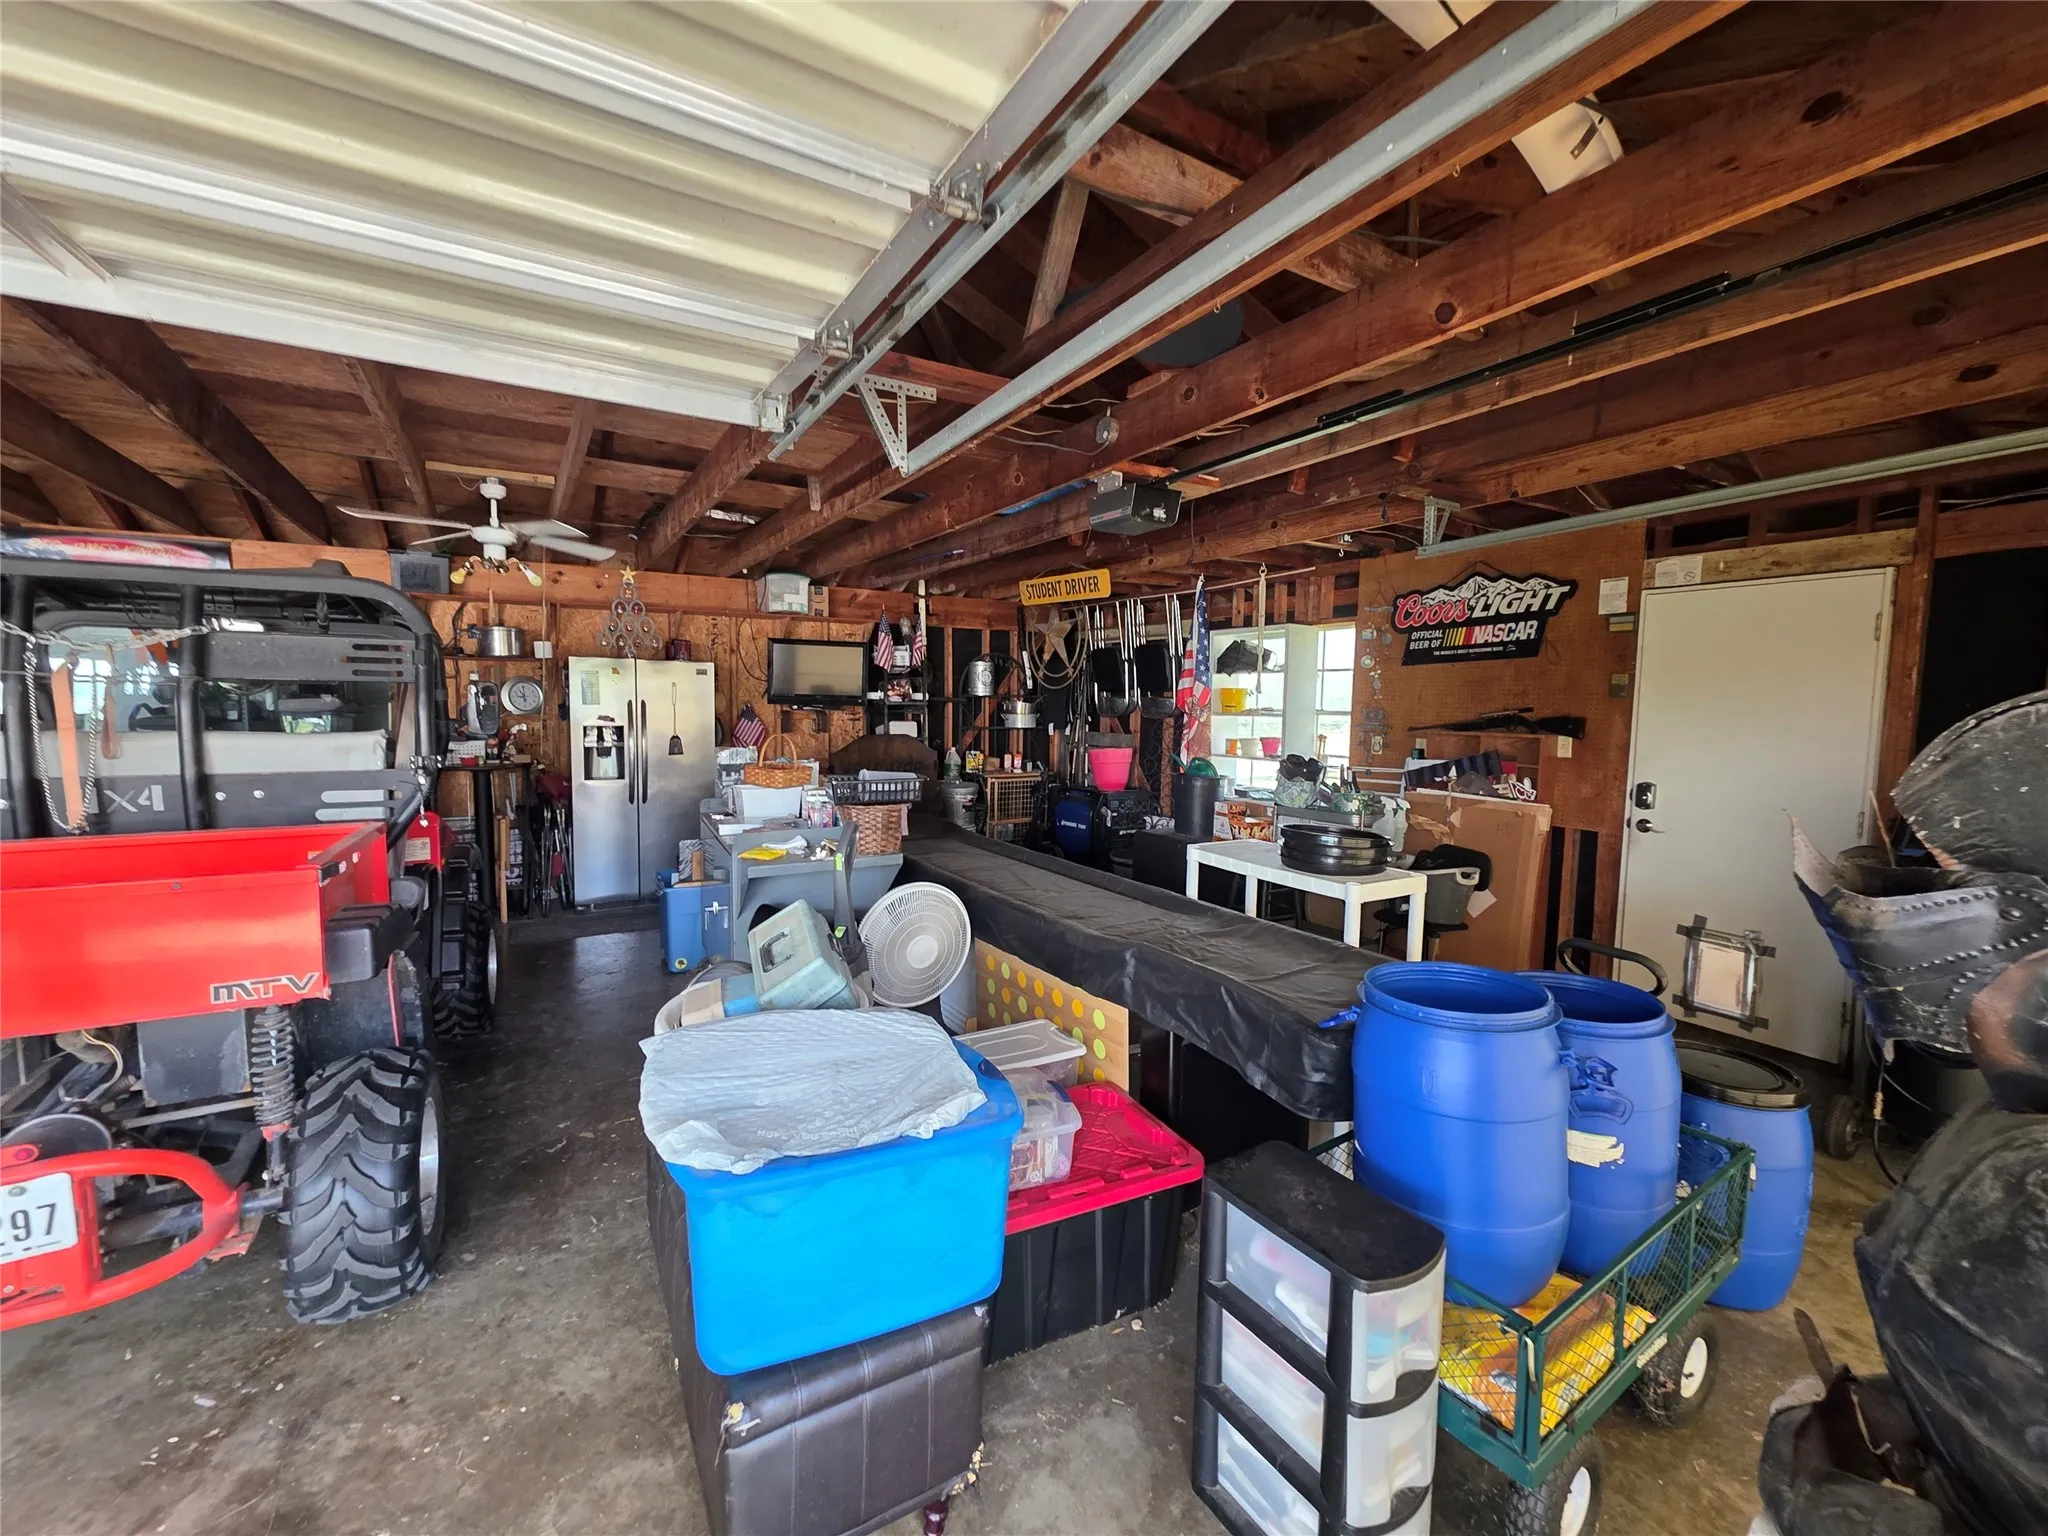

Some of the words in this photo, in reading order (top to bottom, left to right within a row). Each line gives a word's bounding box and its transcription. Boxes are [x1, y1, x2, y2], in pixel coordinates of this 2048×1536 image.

[1025, 581, 1062, 600] STUDENT
[1064, 575, 1100, 596] DRIVER
[1395, 593, 1470, 628] Coors
[1472, 585, 1571, 619] LIGHT
[1409, 640, 1430, 650] BEER
[1430, 639, 1442, 648] OF
[1411, 629, 1443, 640] OFFICIAL
[1472, 620, 1538, 644] NASCAR
[210, 972, 320, 1005] MTV
[0, 1202, 57, 1242] 97
